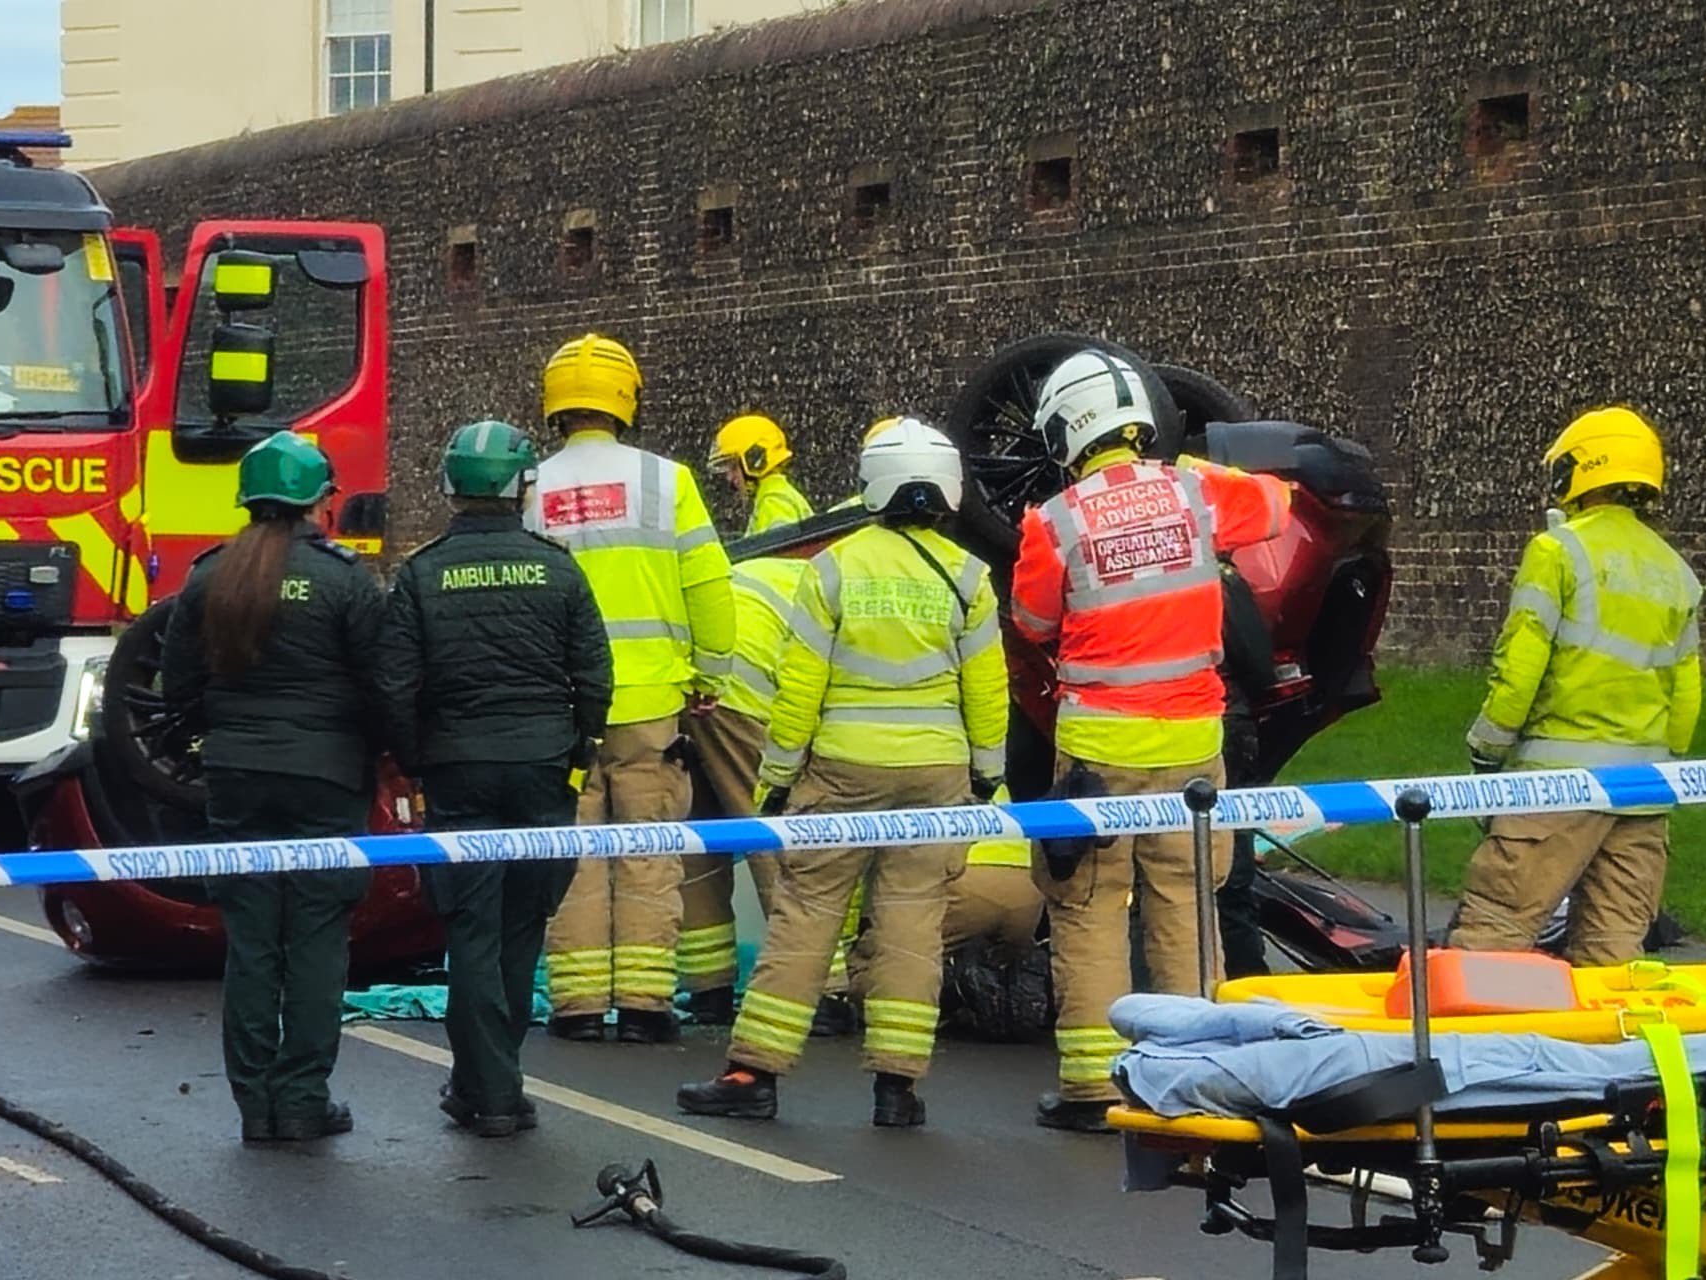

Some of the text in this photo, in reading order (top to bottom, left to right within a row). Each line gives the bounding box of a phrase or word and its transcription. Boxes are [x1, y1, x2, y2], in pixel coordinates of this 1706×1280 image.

[1084, 483, 1171, 512] TACTICAL
[1095, 498, 1173, 529] ADVISOR
[1097, 527, 1185, 556] OPERATIONAL
[1105, 543, 1184, 572] ASSURANCE
[441, 564, 548, 590] AMBULANCE
[846, 600, 951, 625] SERVICE
[1451, 781, 1480, 810] NOT
[1483, 779, 1505, 808] DO
[1507, 777, 1540, 806] LINE
[1539, 774, 1591, 803] POLICE
[1097, 791, 1304, 828] POLICE LINE NOT CROSS
[785, 808, 1004, 844] POLICE LINE DO NOT CROSS
[288, 841, 350, 870] POLICE
[457, 825, 685, 863] POLICE LINE DO NOT CROSS
[246, 845, 284, 873] LINE
